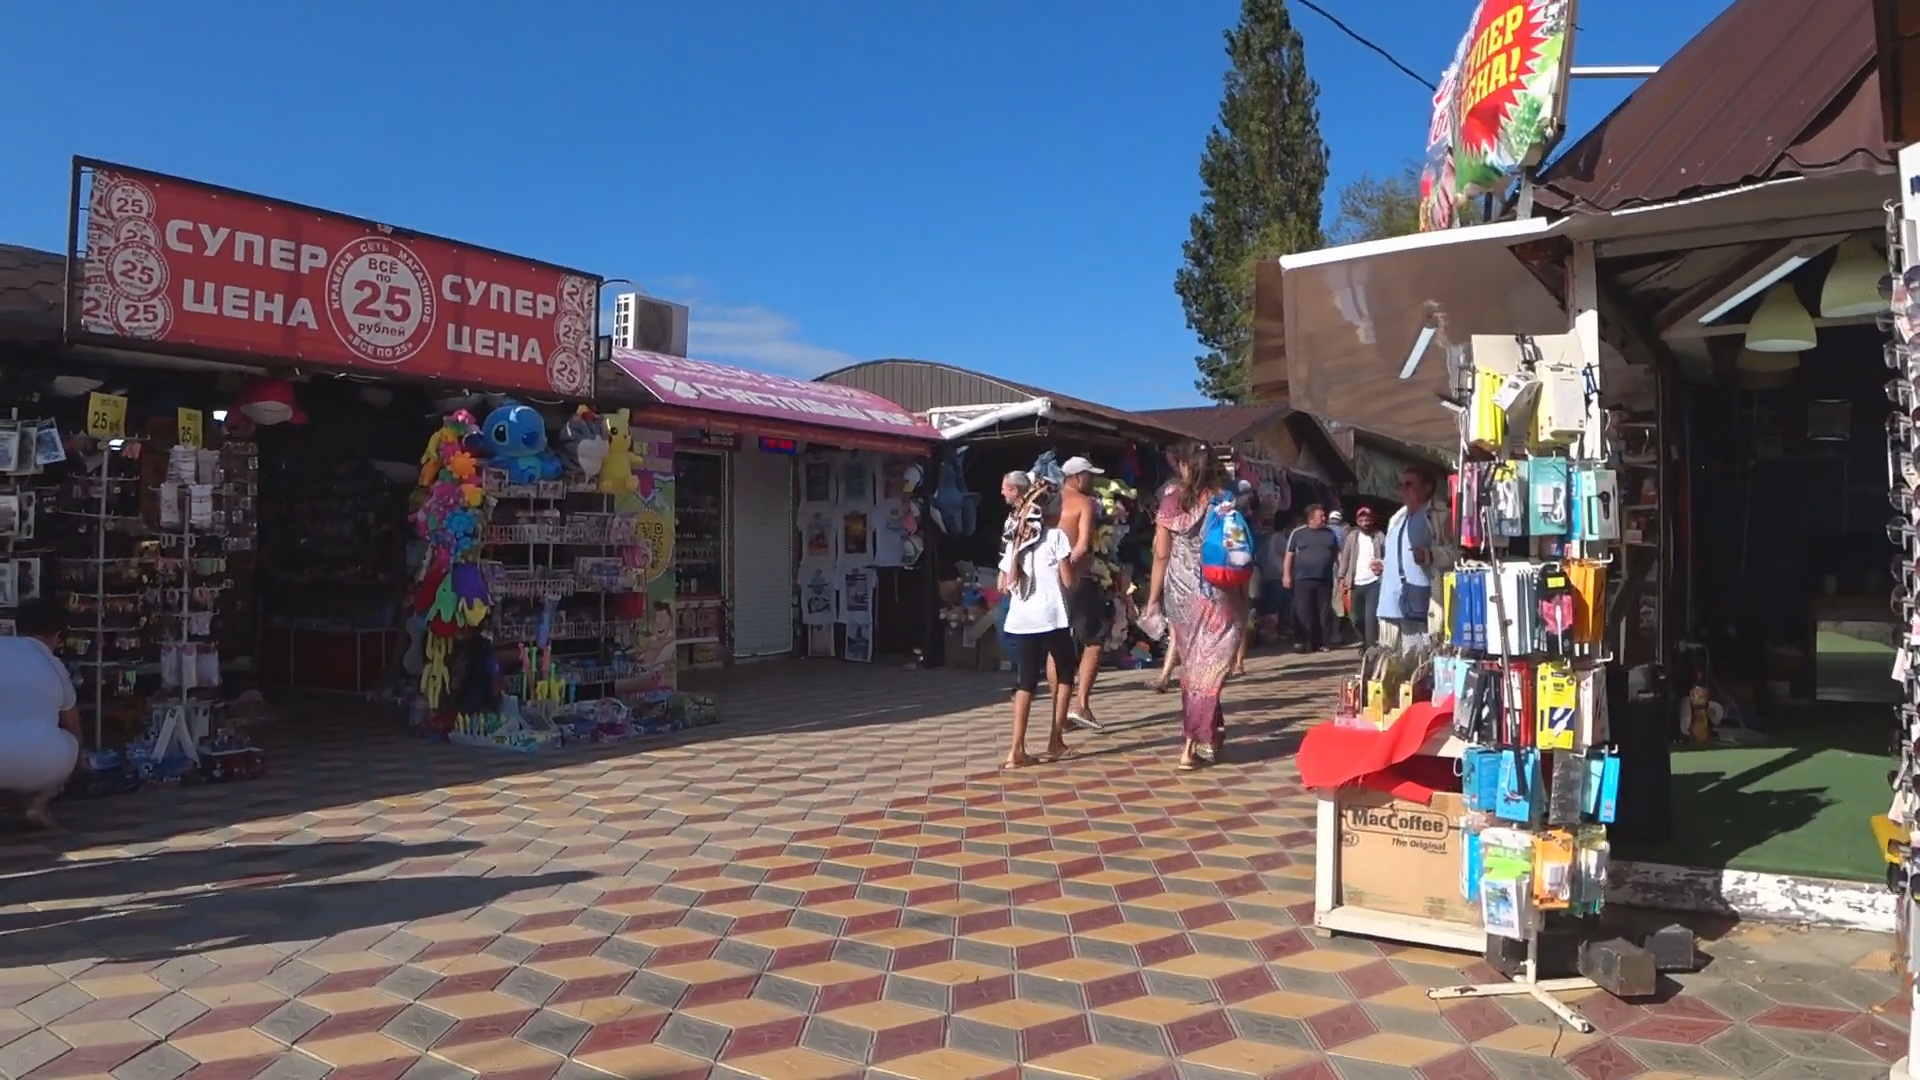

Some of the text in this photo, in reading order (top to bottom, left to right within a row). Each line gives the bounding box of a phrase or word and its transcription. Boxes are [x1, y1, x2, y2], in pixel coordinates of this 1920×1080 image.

[116, 198, 143, 214] 25
[165, 219, 328, 274] СУПЕР
[119, 260, 154, 285] 25
[182, 278, 319, 330] ЦЕНА
[352, 279, 412, 323] 25
[441, 274, 556, 319] СУПЕР
[124, 304, 159, 323] 25
[357, 322, 406, 338] рублей
[446, 322, 544, 365] ЦЕНА
[555, 361, 578, 384] 25
[92, 411, 108, 430] 25
[181, 426, 192, 442] 25
[1352, 808, 1445, 833] MacCoffee
[1391, 838, 1447, 851] The Original
